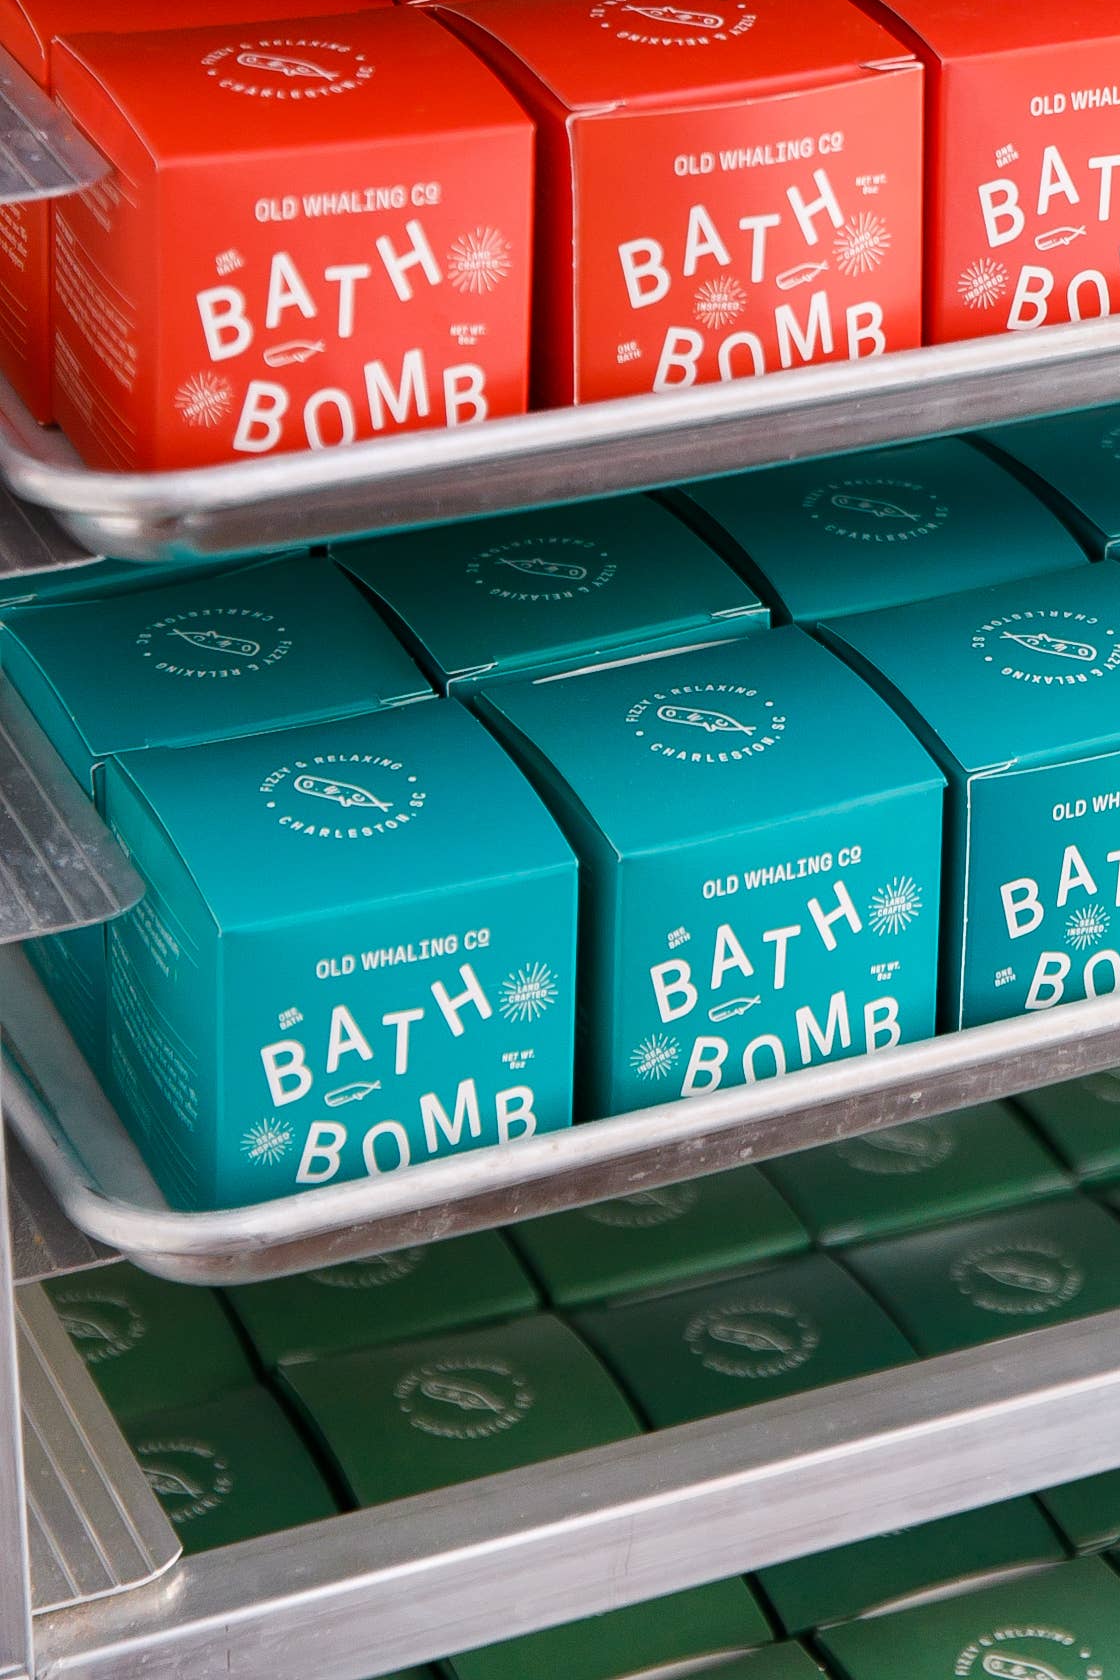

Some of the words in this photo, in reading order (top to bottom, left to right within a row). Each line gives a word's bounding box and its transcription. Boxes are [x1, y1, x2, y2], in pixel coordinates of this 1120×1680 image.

[1030, 93, 1066, 117] OLD
[674, 151, 716, 177] OLD
[719, 139, 813, 171] WHALING
[254, 195, 299, 223] OLD
[302, 185, 407, 218] WHALING
[618, 167, 846, 312] BATH
[196, 220, 443, 362] BATH
[653, 290, 886, 393] BOMB
[232, 348, 488, 453] BOMB
[972, 636, 985, 648] SC
[1001, 667, 1088, 685] RELAXING
[626, 699, 652, 722] FIZZY
[671, 684, 757, 697] RELAXING
[772, 716, 786, 731] SC
[260, 767, 291, 793] FIZZY
[314, 755, 402, 771] RELAXING
[409, 792, 426, 808] SC
[1052, 799, 1087, 821] OLD
[702, 874, 740, 899] OLD
[743, 852, 833, 890] WHALING
[315, 954, 356, 980] OLD
[360, 934, 459, 971] WHALING
[650, 880, 863, 1024] BATH
[260, 963, 492, 1108] BATH
[681, 990, 901, 1097] BOMB
[295, 1077, 537, 1184] BOMB
